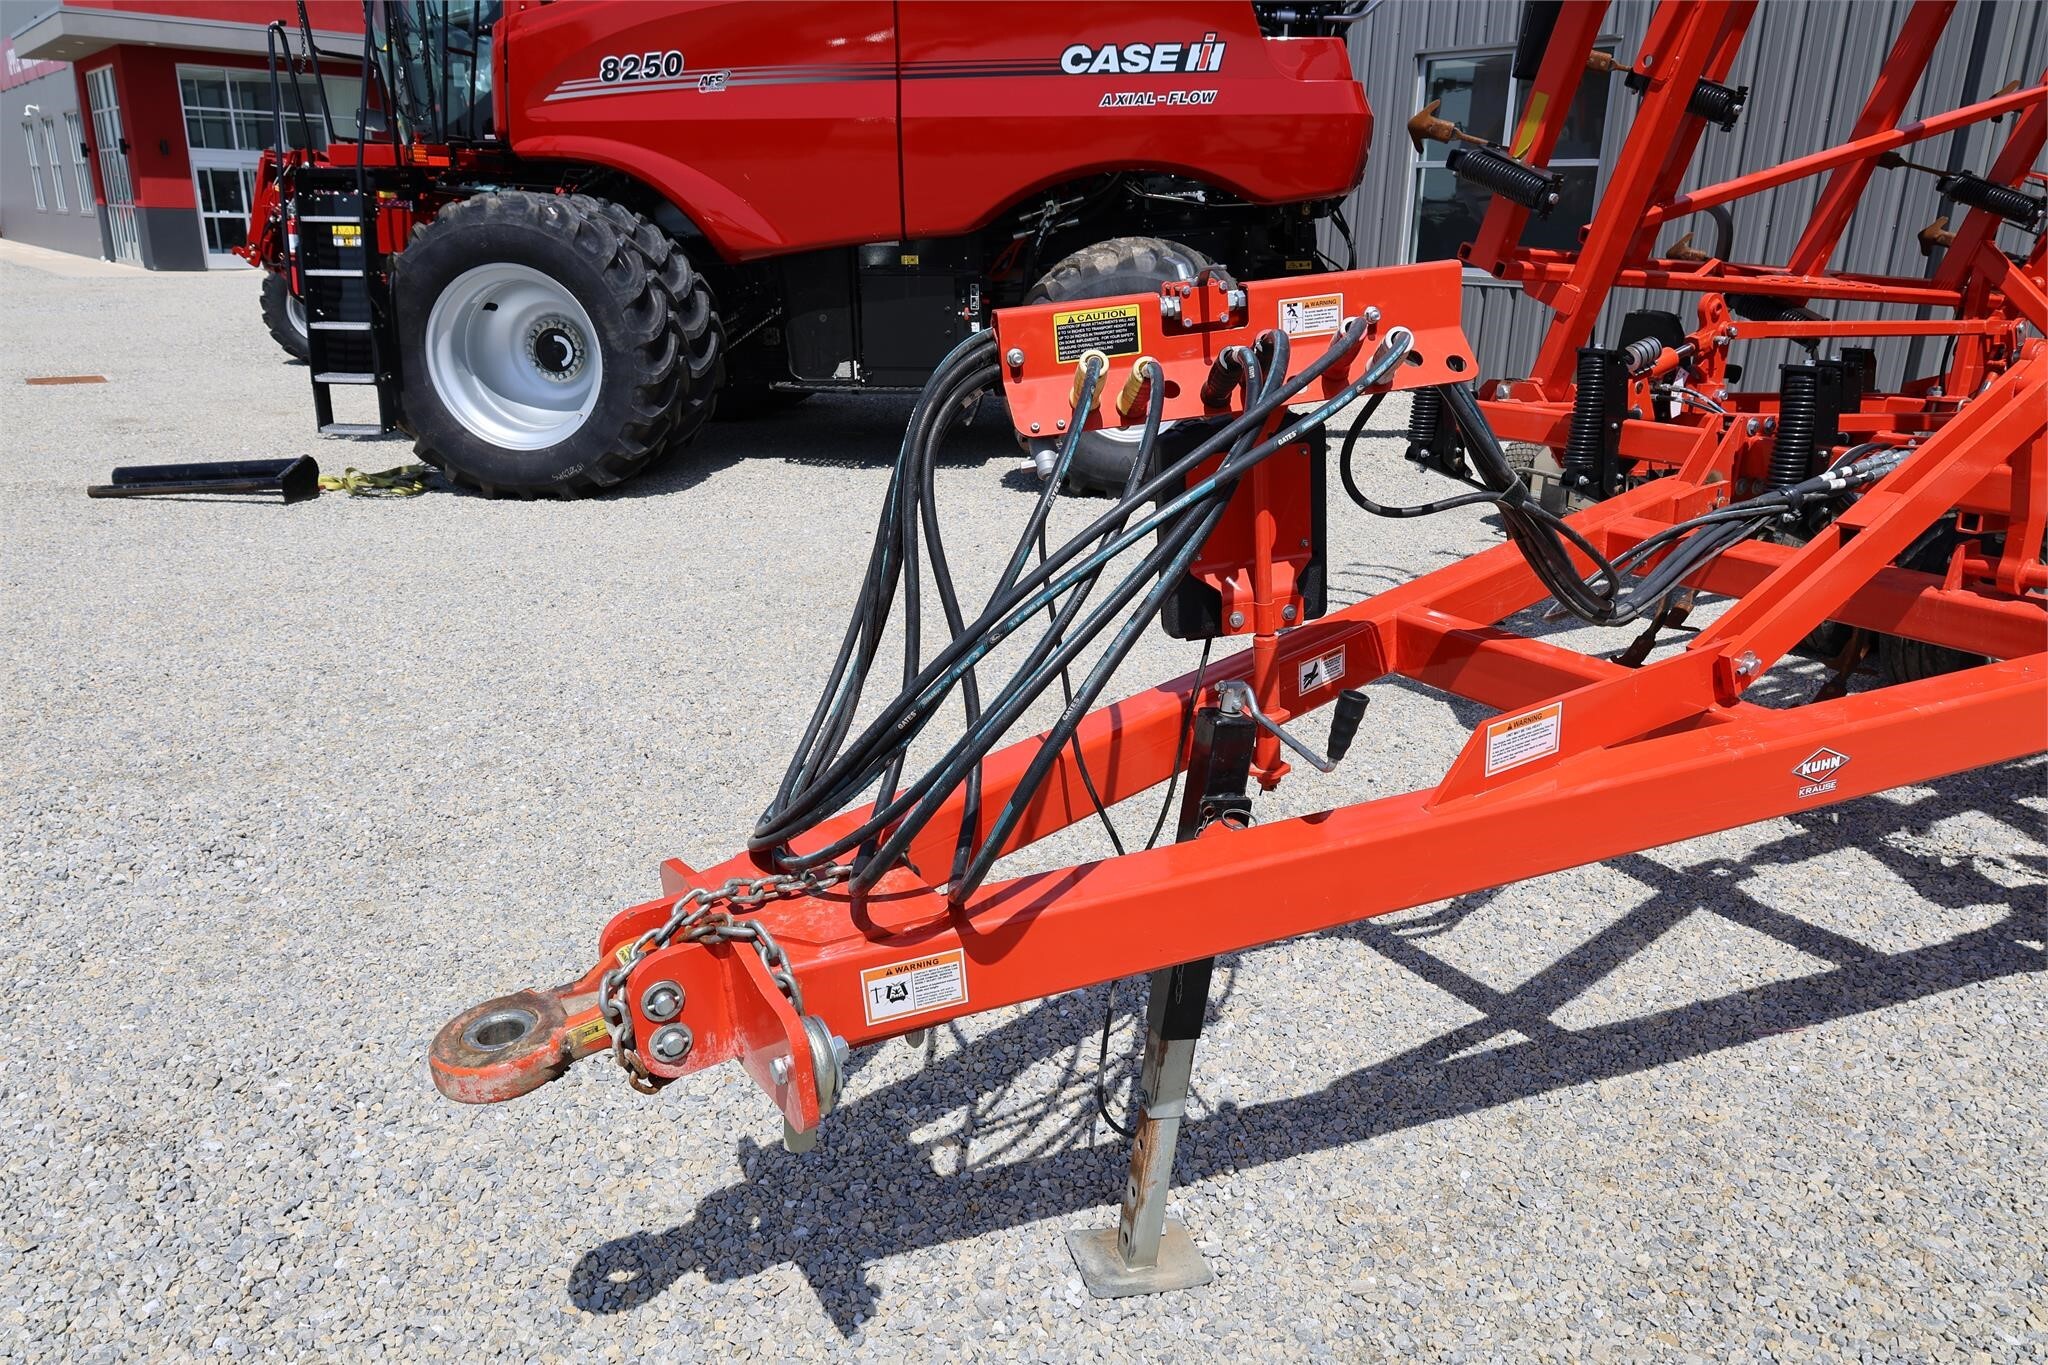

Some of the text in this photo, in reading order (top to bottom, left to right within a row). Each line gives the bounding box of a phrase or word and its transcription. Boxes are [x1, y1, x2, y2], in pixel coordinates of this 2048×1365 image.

[600, 50, 684, 83] 8250
[1061, 44, 1182, 74] CASE
[699, 73, 724, 87] AFS
[1099, 90, 1218, 107] AXIAL-FLOW
[1310, 299, 1337, 307] WARNING
[1077, 310, 1126, 322] CAUTION
[1062, 696, 1080, 720] GATES
[897, 711, 916, 730] GATES
[1513, 713, 1542, 728] WARNING
[1802, 756, 1840, 775] KUHN
[1799, 781, 1837, 796] KRAUSE
[895, 959, 939, 974] WARNING
